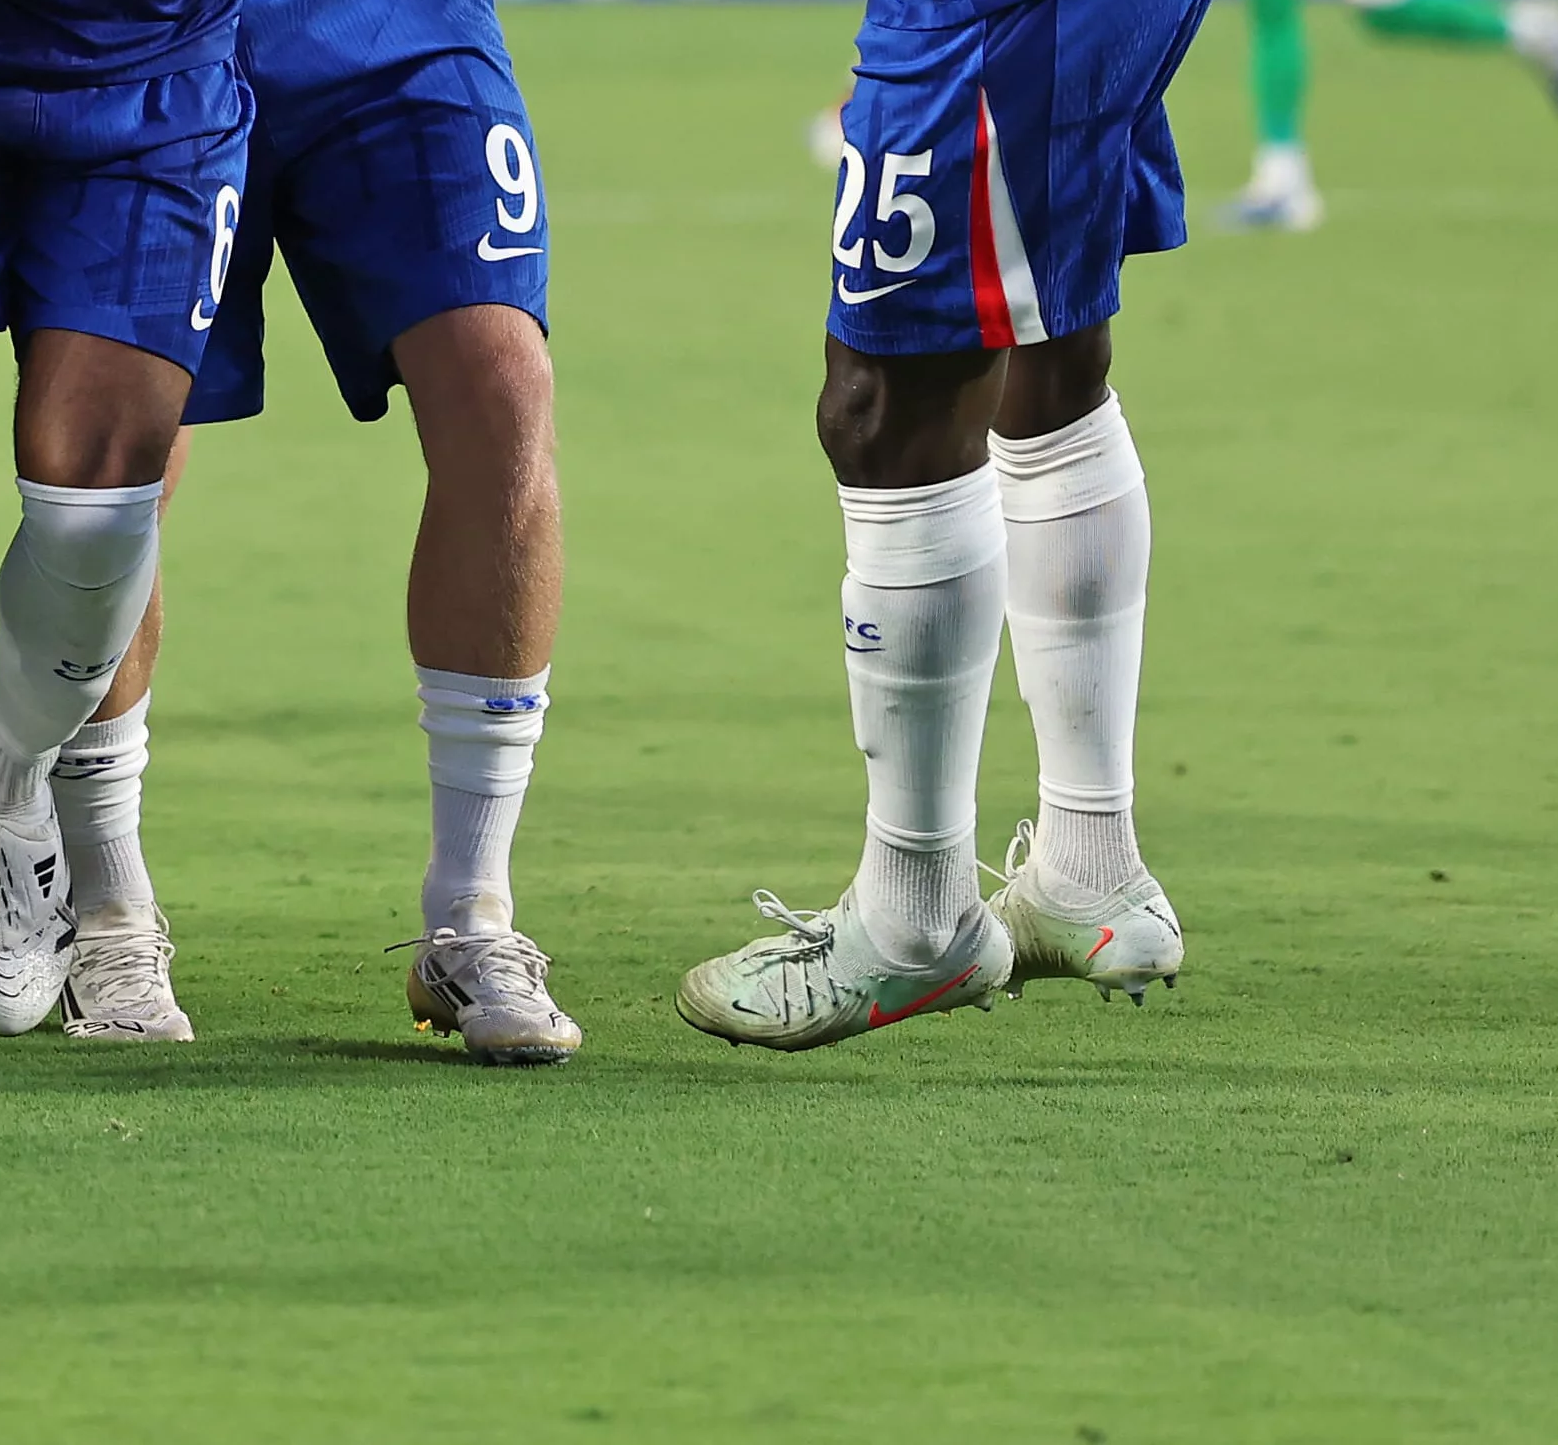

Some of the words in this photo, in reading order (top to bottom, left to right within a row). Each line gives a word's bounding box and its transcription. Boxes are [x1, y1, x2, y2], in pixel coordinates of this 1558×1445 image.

[485, 123, 539, 234] 9
[833, 140, 936, 273] 25
[210, 184, 241, 305] 6
[845, 615, 882, 641] FC
